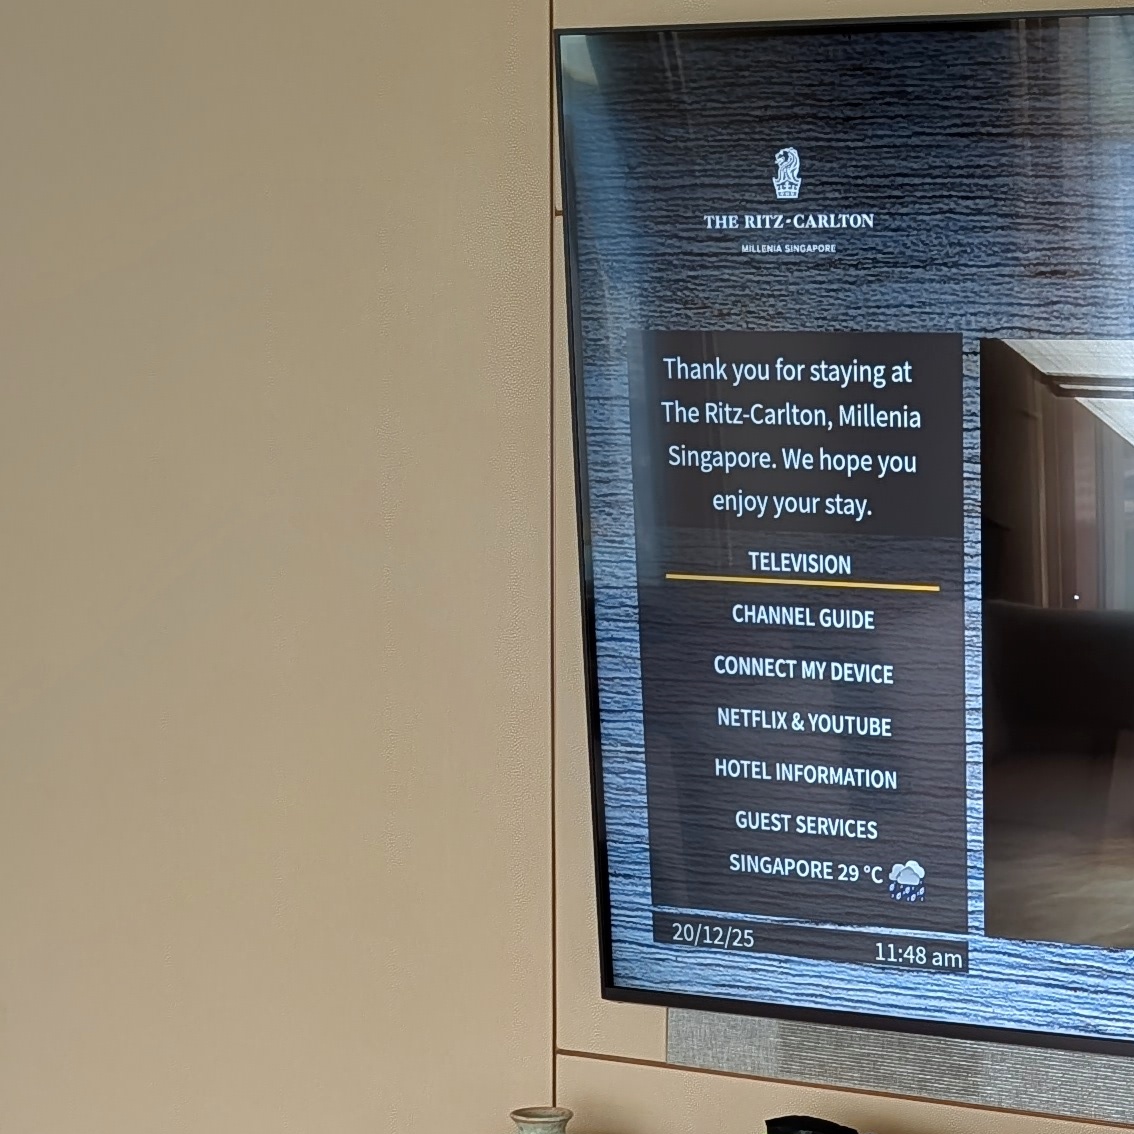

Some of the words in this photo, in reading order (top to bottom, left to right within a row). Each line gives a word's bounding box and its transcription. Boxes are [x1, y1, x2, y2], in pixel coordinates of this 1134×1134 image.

[703, 214, 739, 229] THE
[744, 213, 874, 229] RITZ-CARLTON
[741, 244, 782, 253] MILLENIA
[785, 244, 836, 253] SINGAPORE
[663, 357, 727, 382] Thank
[732, 362, 770, 387] you
[774, 357, 806, 382] for
[810, 357, 886, 389] staying
[891, 361, 912, 384] at
[661, 401, 701, 424] The
[705, 402, 833, 431] Ritz-Carlton,
[838, 404, 922, 430] Millenia
[668, 444, 778, 475] Singapore.
[781, 446, 815, 471] We
[819, 446, 874, 477] hope
[878, 453, 917, 478] you
[712, 490, 769, 519] enjoy
[772, 494, 820, 520] your
[824, 494, 873, 520] stay.
[748, 551, 852, 575] TELEVISION
[732, 604, 815, 627] CHANNEL
[819, 608, 875, 630] GUIDE
[713, 655, 797, 679] CONNECT
[801, 659, 827, 680] MY
[830, 662, 894, 685] DEVICE
[717, 707, 787, 730] NETFLIX
[791, 711, 805, 731] &
[808, 713, 892, 737] YOUTUBE
[715, 758, 771, 781] HOTEL
[776, 762, 897, 790] INFORMATION
[735, 810, 791, 832] GUEST
[795, 815, 878, 840] SERVICES
[729, 853, 833, 880] SINGAPORE
[838, 863, 859, 882] 29
[863, 864, 883, 884] °C
[672, 922, 755, 948] 20/12/25
[874, 941, 927, 965] 11:48
[931, 951, 963, 969] am
